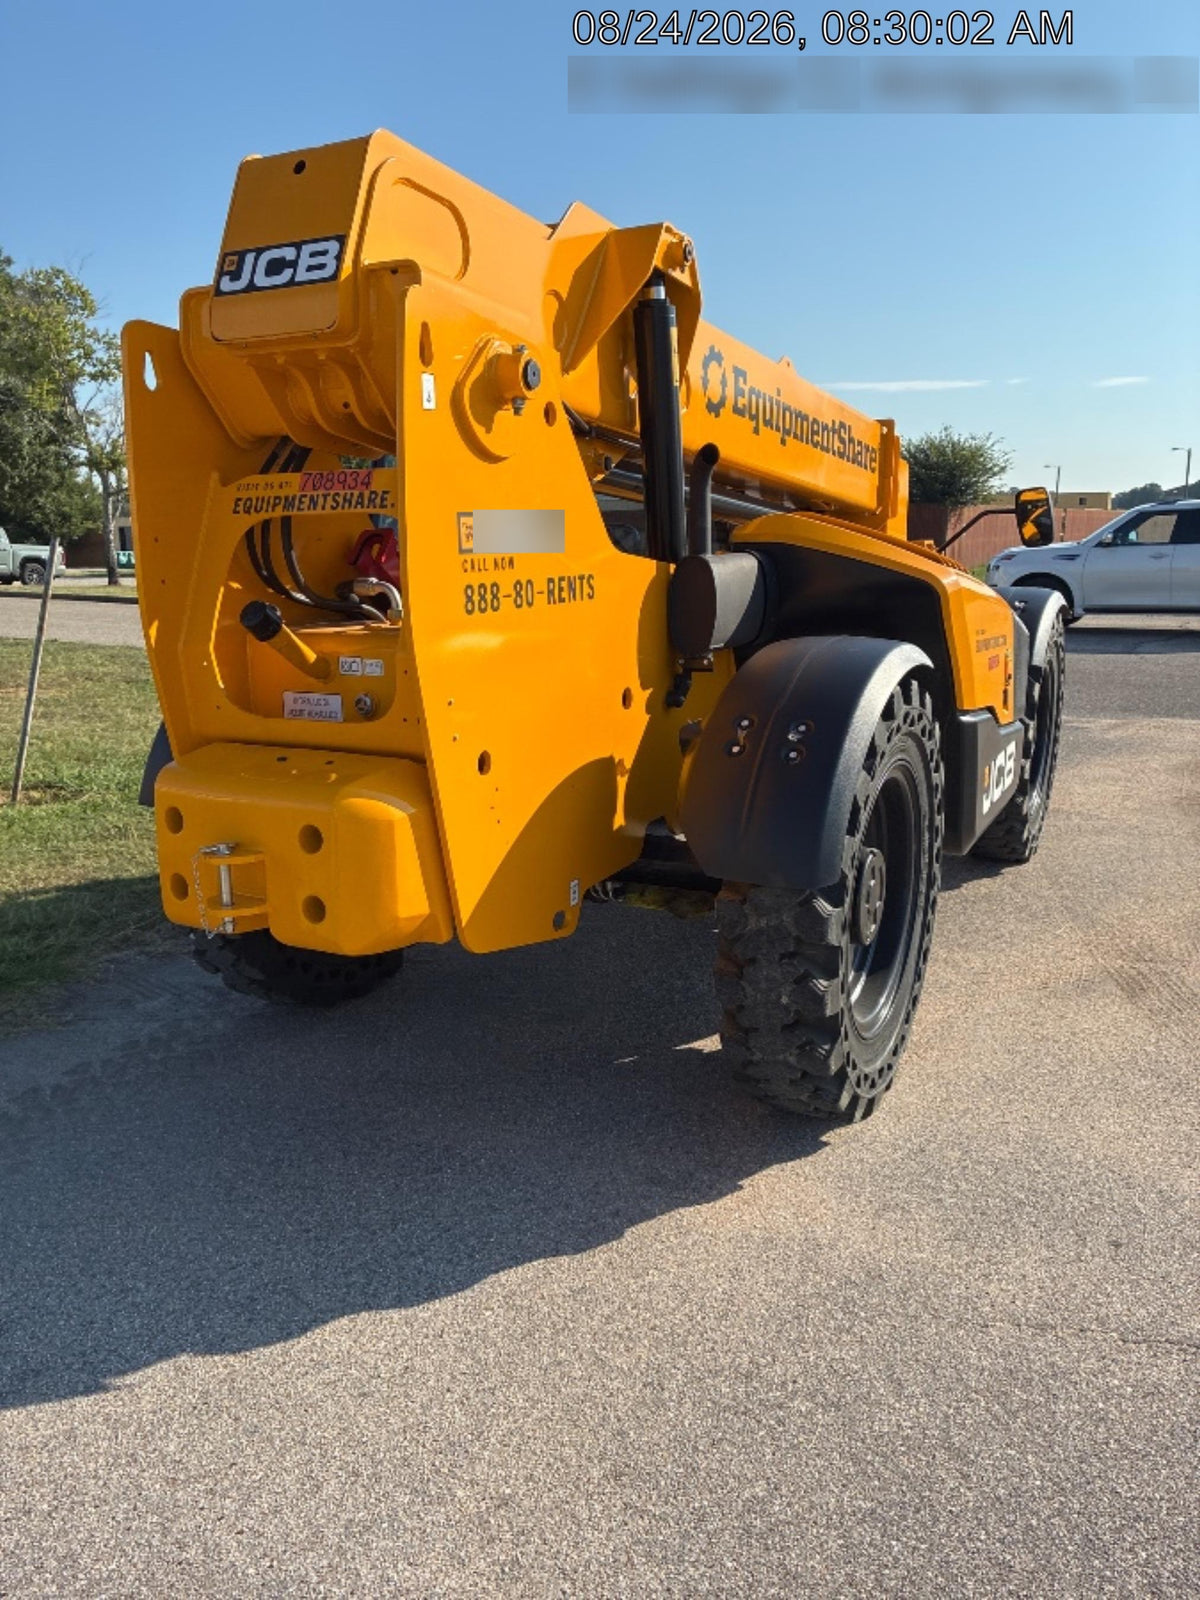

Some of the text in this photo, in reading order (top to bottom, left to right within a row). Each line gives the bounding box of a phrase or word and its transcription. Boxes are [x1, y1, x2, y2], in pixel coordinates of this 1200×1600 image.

[219, 239, 341, 293] JCB
[731, 364, 878, 474] EquipmentShare
[301, 470, 373, 491] 708934
[462, 556, 515, 573] CALL NOW
[463, 573, 595, 616] 888-80-RENTS
[982, 740, 1017, 816] JCB
